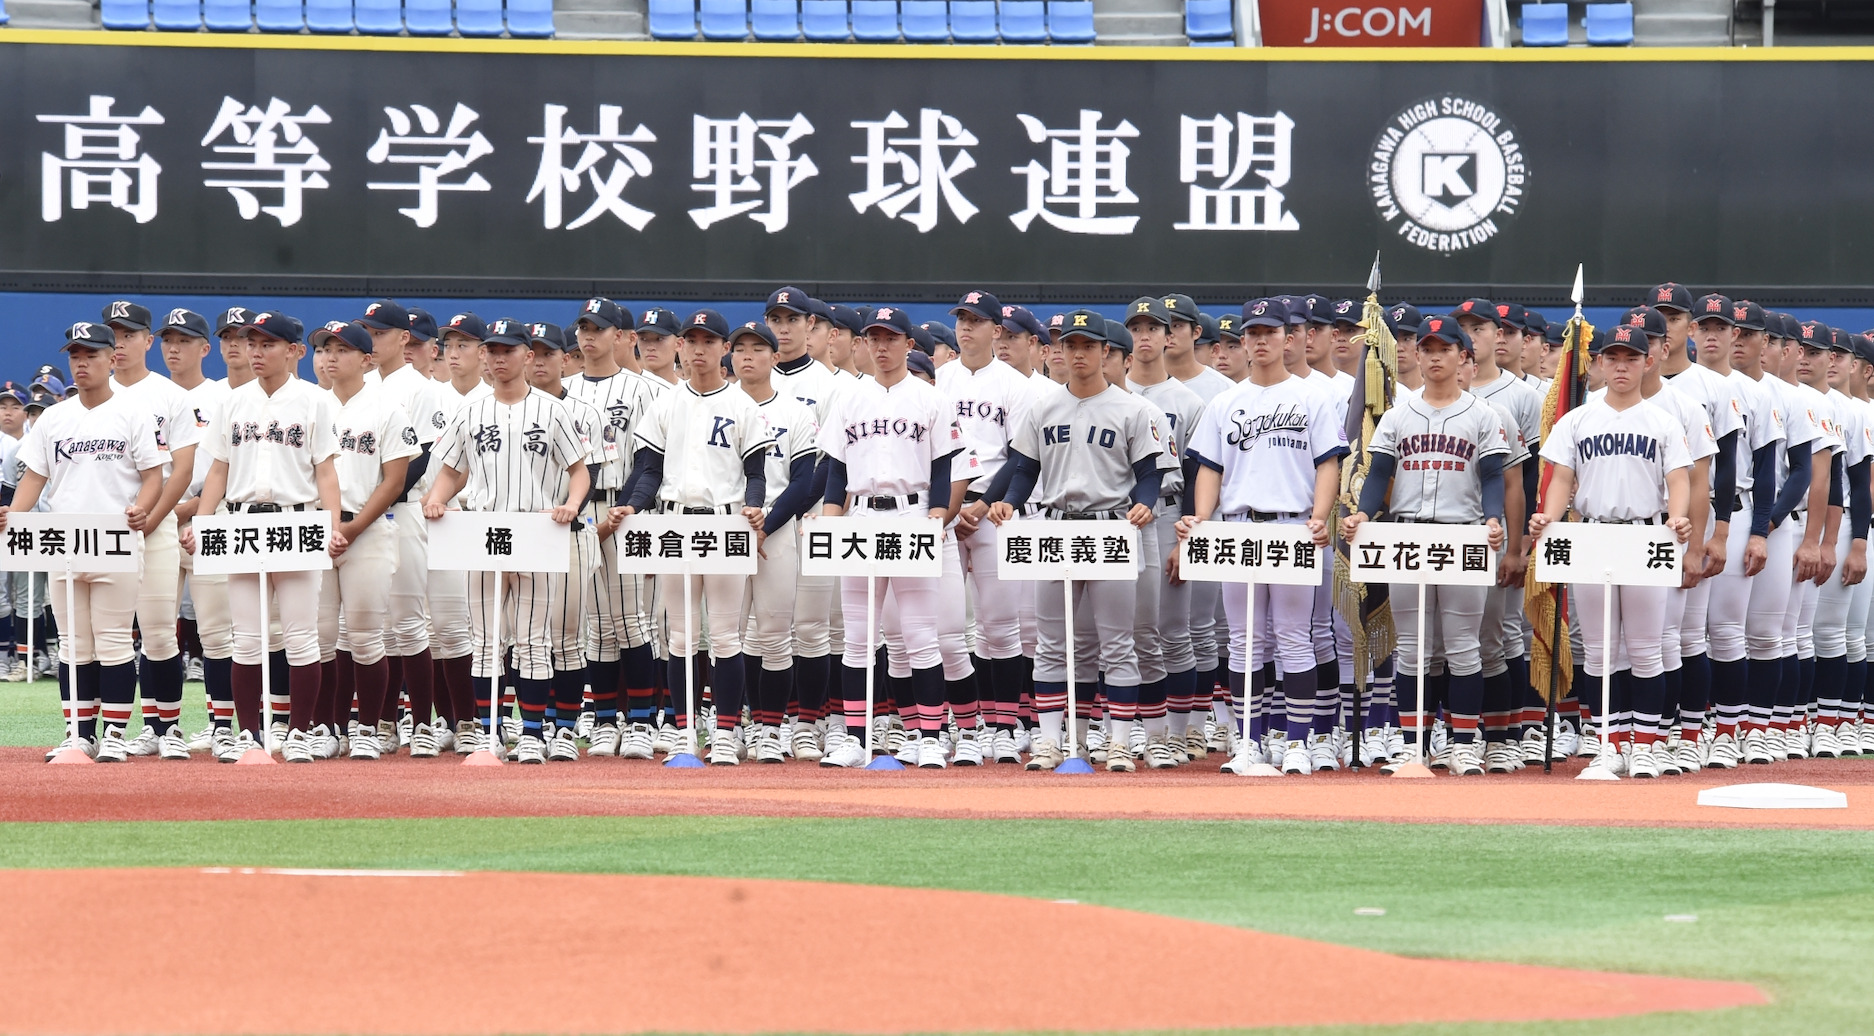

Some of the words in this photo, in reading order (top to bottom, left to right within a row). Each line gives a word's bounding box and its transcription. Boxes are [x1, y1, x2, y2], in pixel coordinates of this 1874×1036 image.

[1303, 7, 1432, 43] J:COM
[36, 95, 1299, 233] 高等学校野球連盟
[1371, 127, 1404, 222] KANAGAWA
[1397, 99, 1439, 131] HIGH
[1441, 96, 1501, 136] SCHOOL
[1495, 129, 1525, 215] BASEBALL
[1423, 154, 1475, 197] K
[1398, 217, 1499, 252] FEDERATION
[111, 301, 132, 318] K
[168, 308, 188, 325] K
[227, 307, 246, 324] K
[1136, 302, 1150, 313] K
[1164, 299, 1177, 309] K
[72, 321, 93, 339] K
[1073, 315, 1088, 327] K
[1219, 319, 1233, 330] K
[606, 398, 629, 433] 高
[707, 416, 735, 449] K
[845, 417, 929, 447] NIHON
[54, 437, 128, 465] Kanagawa
[1577, 433, 1657, 464] YOKOHAMA
[1402, 460, 1465, 472] GAKUEN
[7, 527, 132, 557] 神奈川工
[201, 525, 325, 556] 藤沢翔陵
[486, 527, 512, 555] 橘
[625, 530, 750, 558] 鎌倉学園
[809, 532, 935, 560] 日大藤沢
[1006, 535, 1130, 563] 慶應義塾
[1187, 536, 1316, 569] 横浜創学館
[1358, 541, 1489, 572] 立花学園
